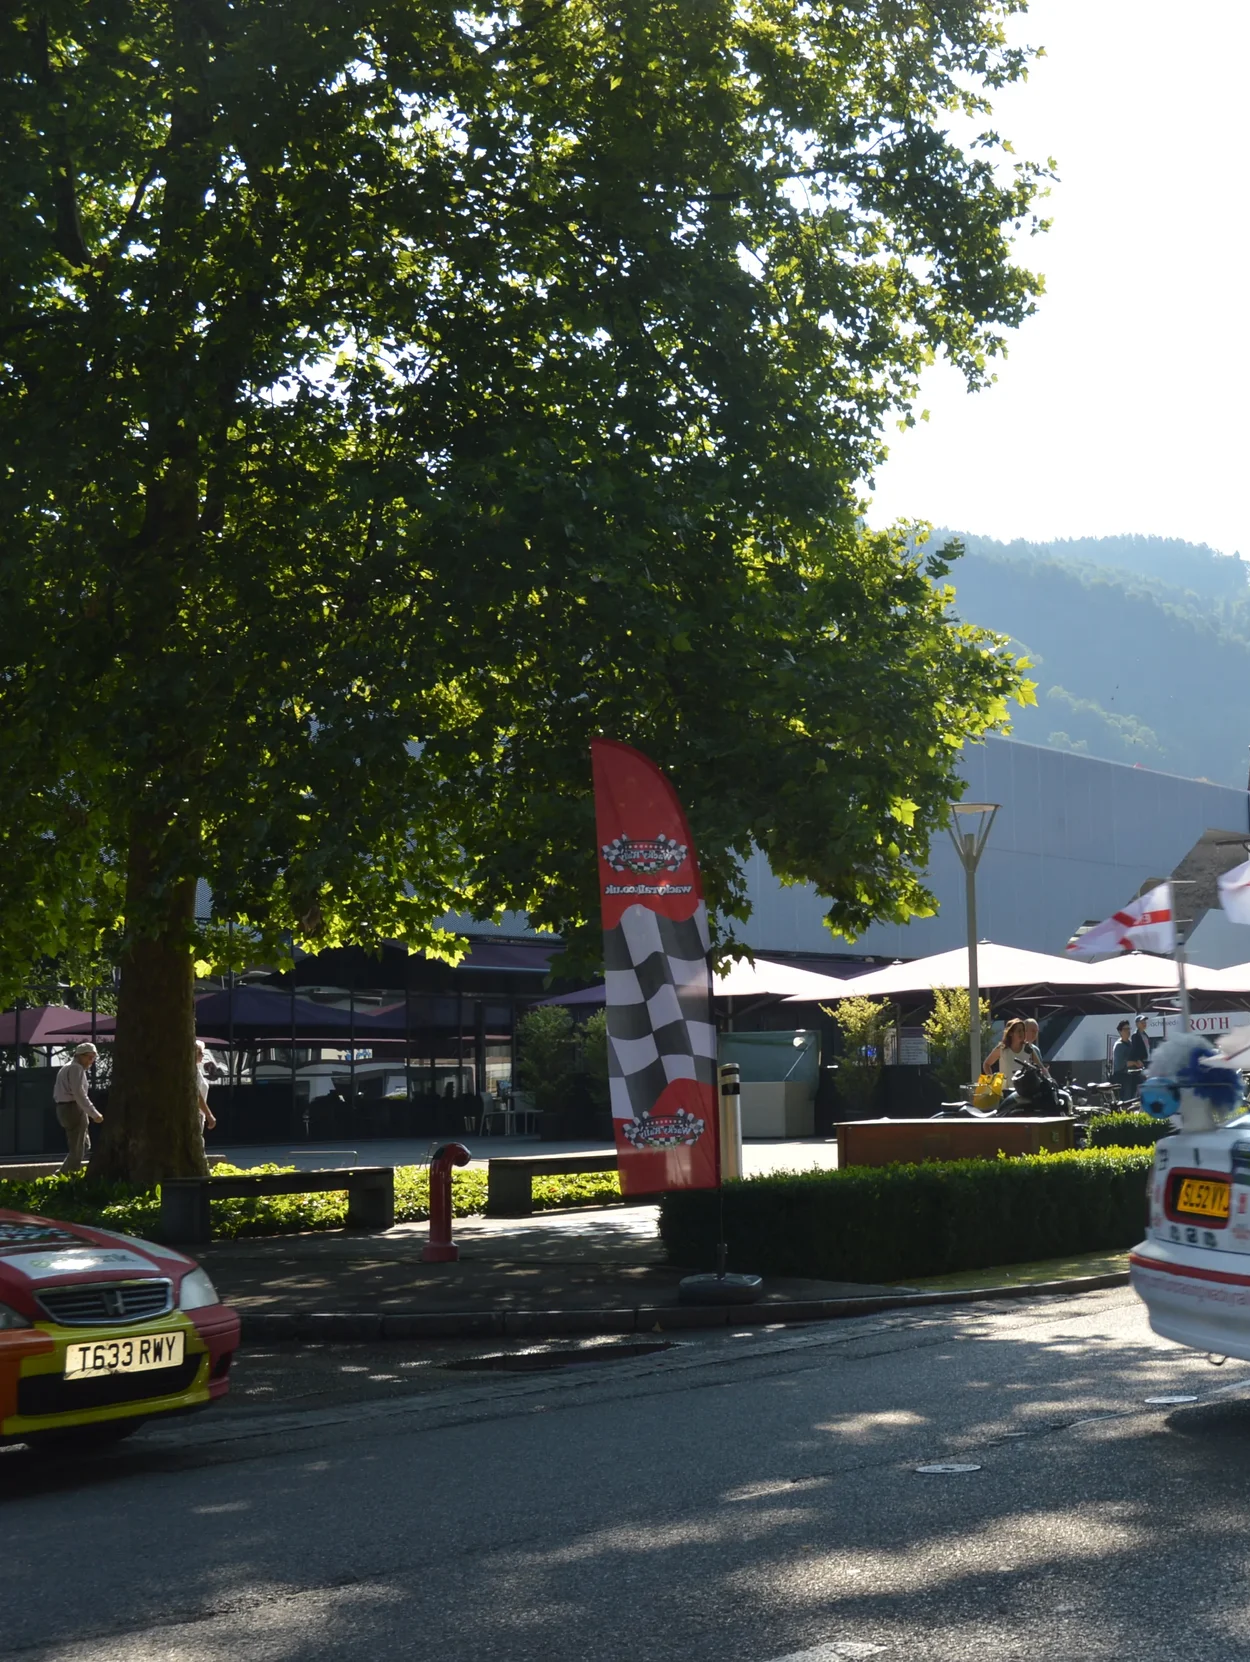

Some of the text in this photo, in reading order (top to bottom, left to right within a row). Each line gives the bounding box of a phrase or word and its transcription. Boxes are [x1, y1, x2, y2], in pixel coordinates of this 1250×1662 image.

[1189, 1016, 1229, 1031] ROTH
[78, 1336, 177, 1372] T633 RWY
